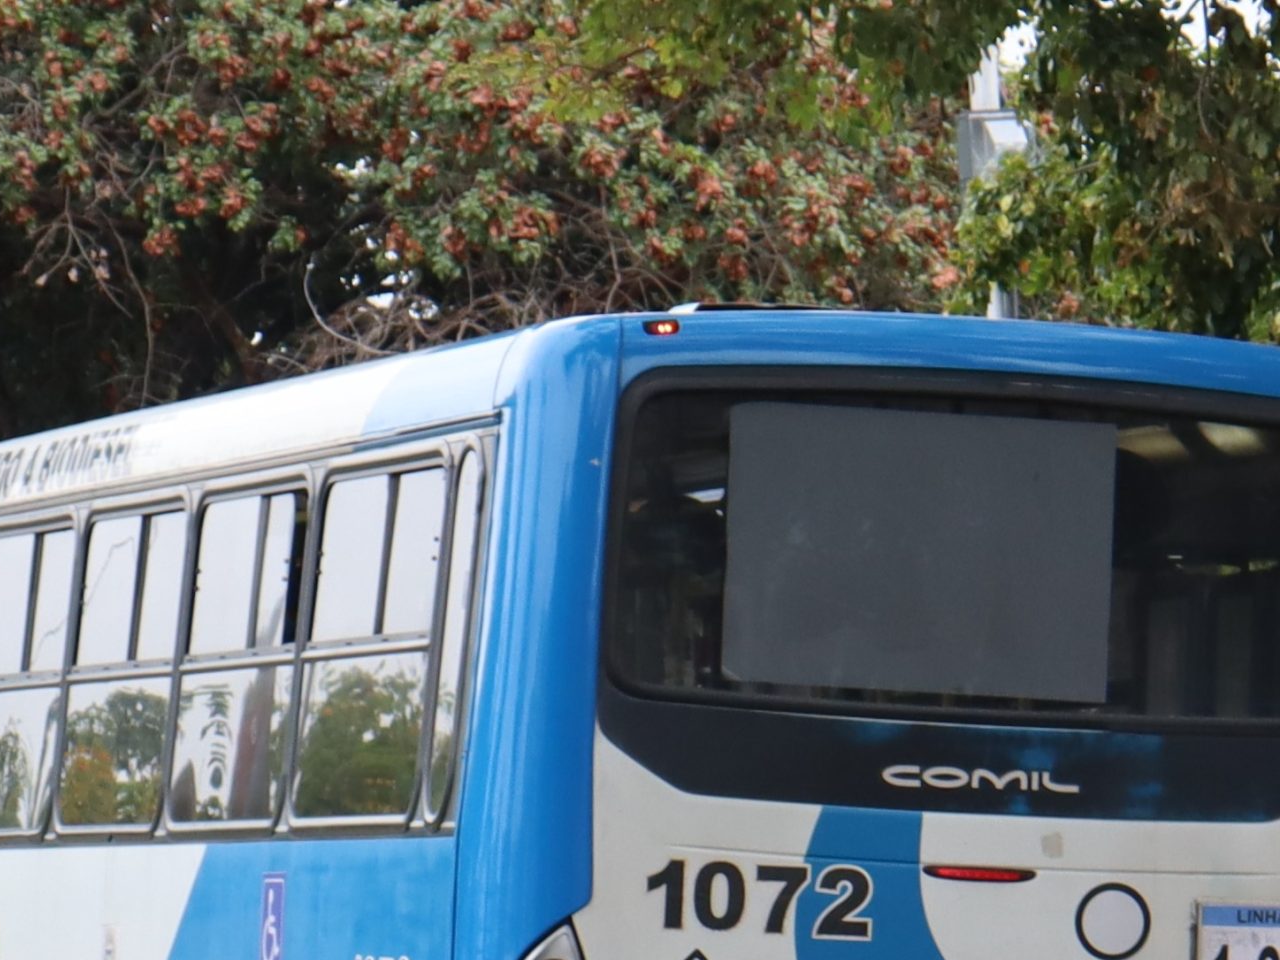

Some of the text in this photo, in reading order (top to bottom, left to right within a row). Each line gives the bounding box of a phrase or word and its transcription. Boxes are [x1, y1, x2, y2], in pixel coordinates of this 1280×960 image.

[882, 764, 1080, 794] COMIL
[646, 858, 873, 941] 1072
[1236, 909, 1280, 924] LINH
